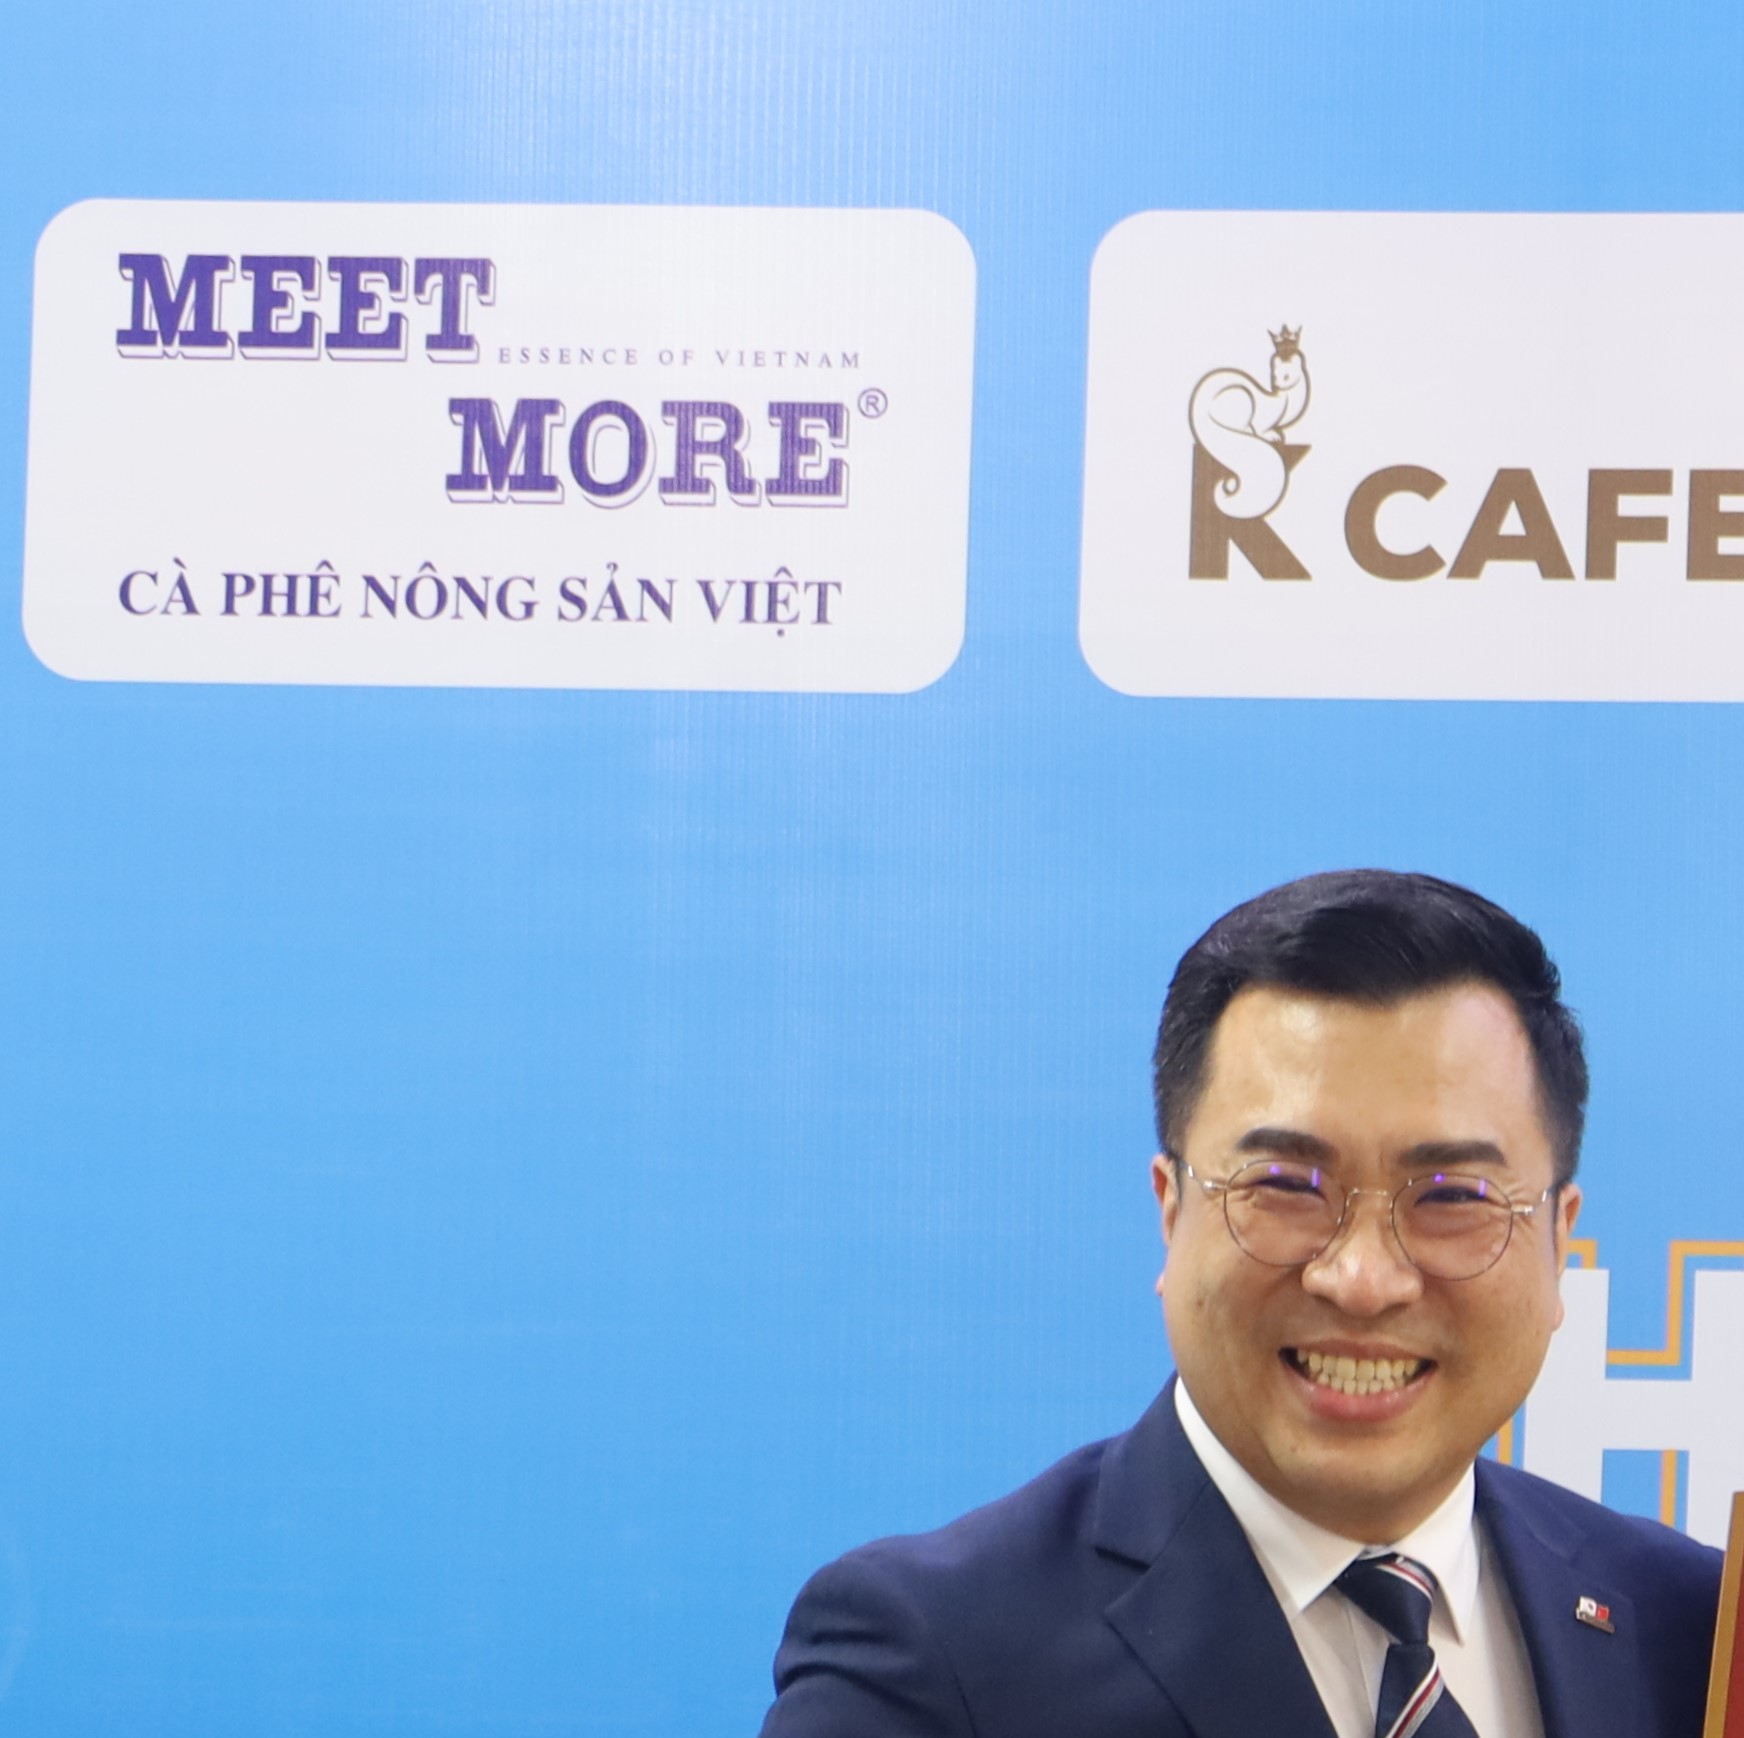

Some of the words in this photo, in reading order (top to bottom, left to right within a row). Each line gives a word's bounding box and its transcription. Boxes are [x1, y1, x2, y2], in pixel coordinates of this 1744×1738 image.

[116, 253, 495, 364] MEET
[498, 347, 638, 366] ESSENCE
[658, 349, 696, 367] OF
[715, 349, 861, 369] VIETNAM
[118, 557, 200, 616] CÀ
[221, 559, 341, 618] PHÊ
[361, 561, 539, 621] NÔNG
[556, 562, 676, 622] SẢN
[696, 566, 842, 637] VIỆT
